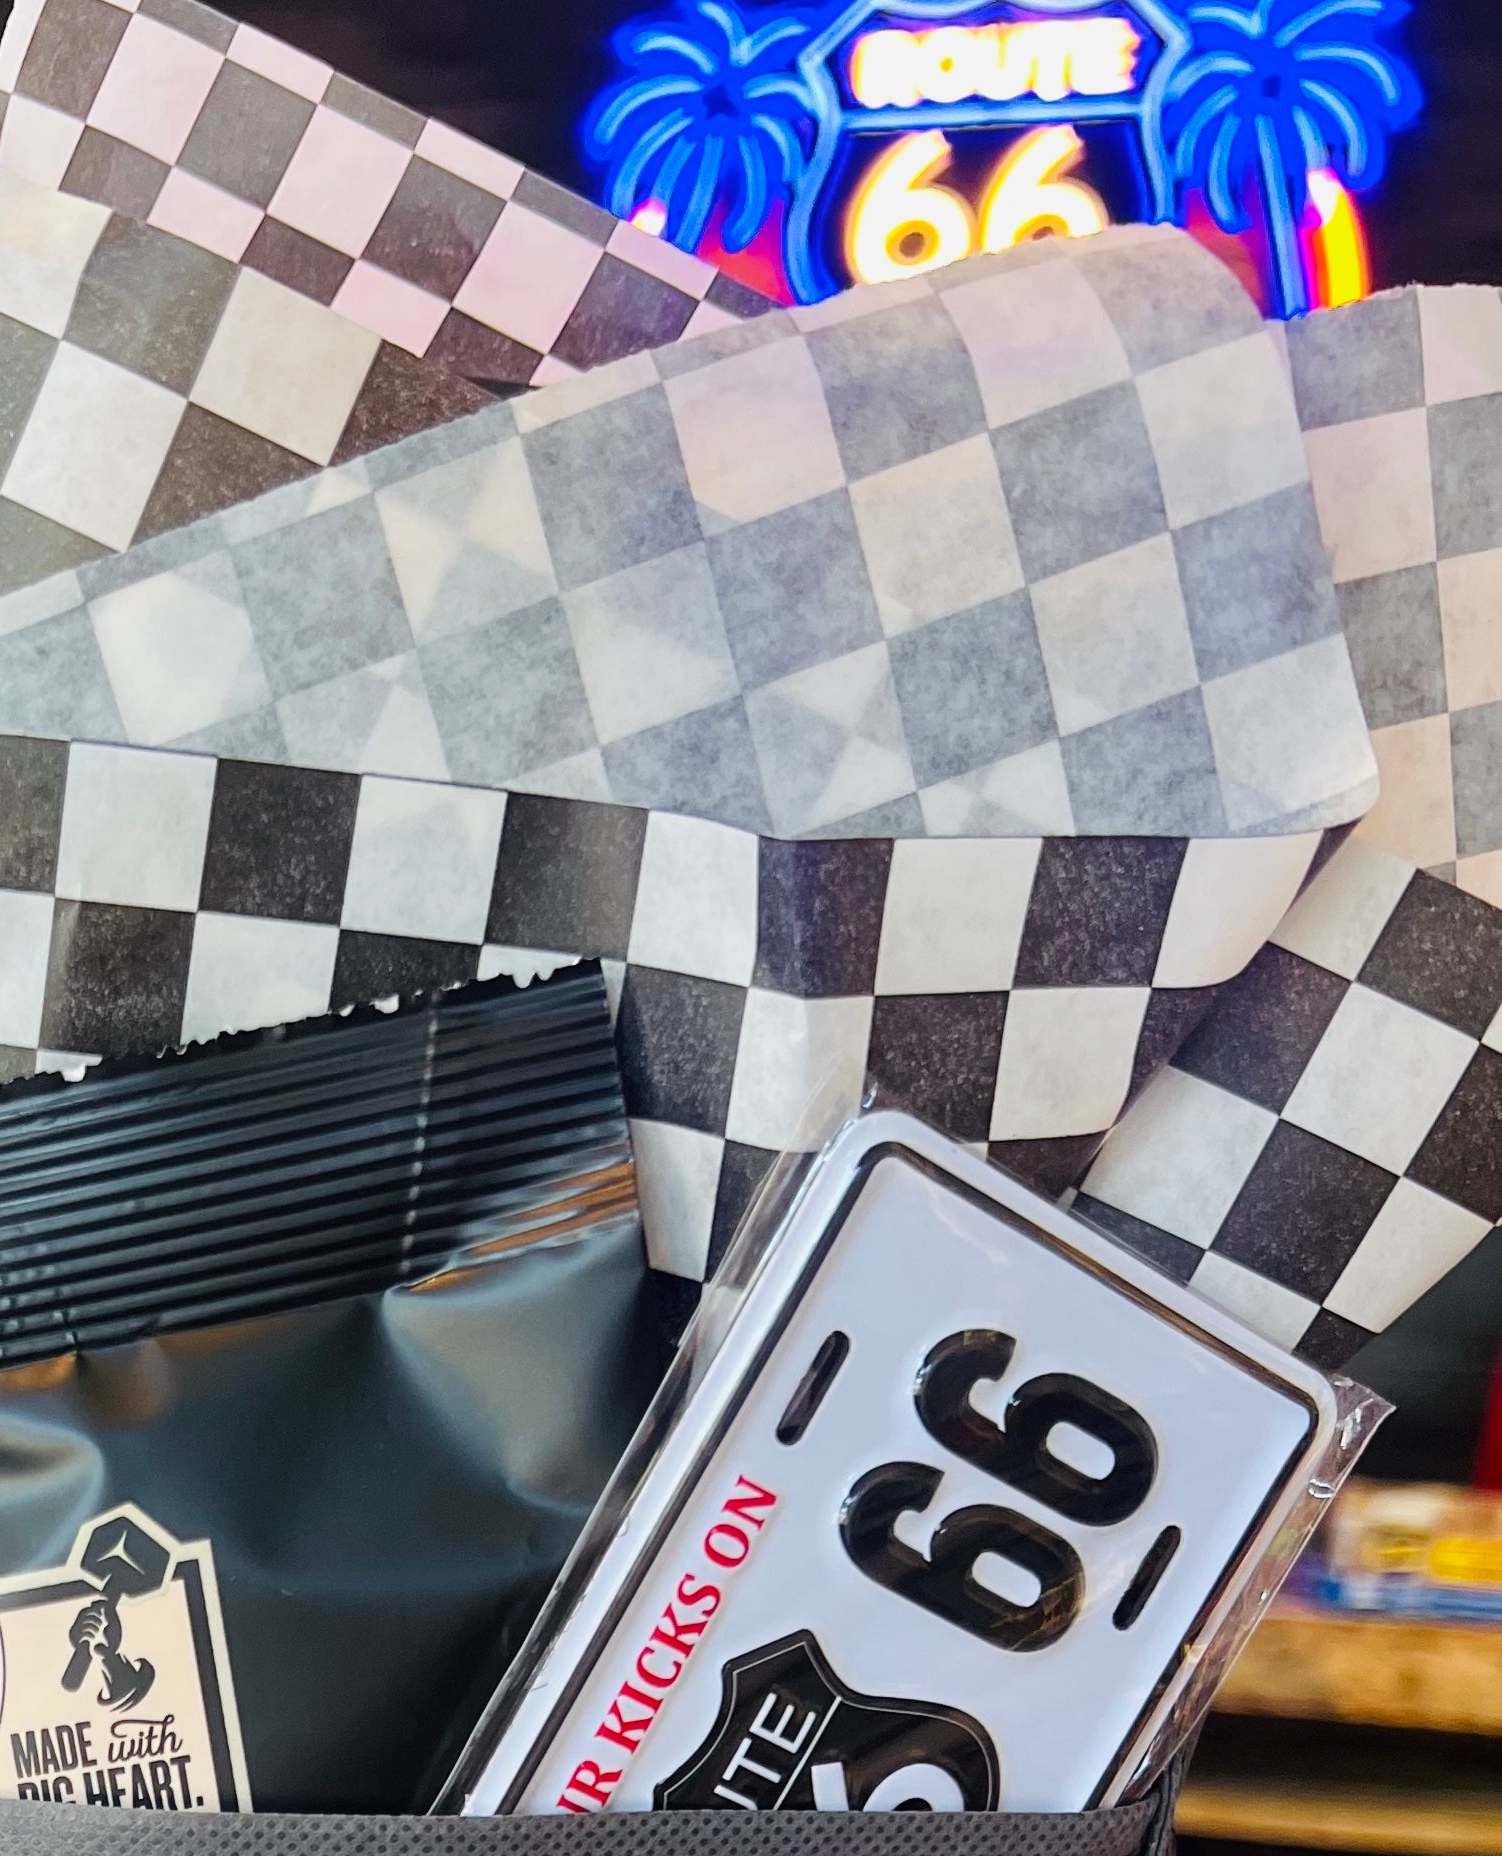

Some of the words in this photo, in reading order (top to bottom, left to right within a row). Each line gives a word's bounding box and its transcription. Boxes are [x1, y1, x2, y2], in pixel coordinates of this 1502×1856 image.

[852, 17, 1141, 109] ROUTE
[848, 123, 1109, 285] 66
[833, 1327, 1160, 1654] 66
[594, 1572, 722, 1756] KICKS
[703, 1474, 778, 1569] ON
[10, 1721, 98, 1779] MADE
[106, 1714, 184, 1763] with
